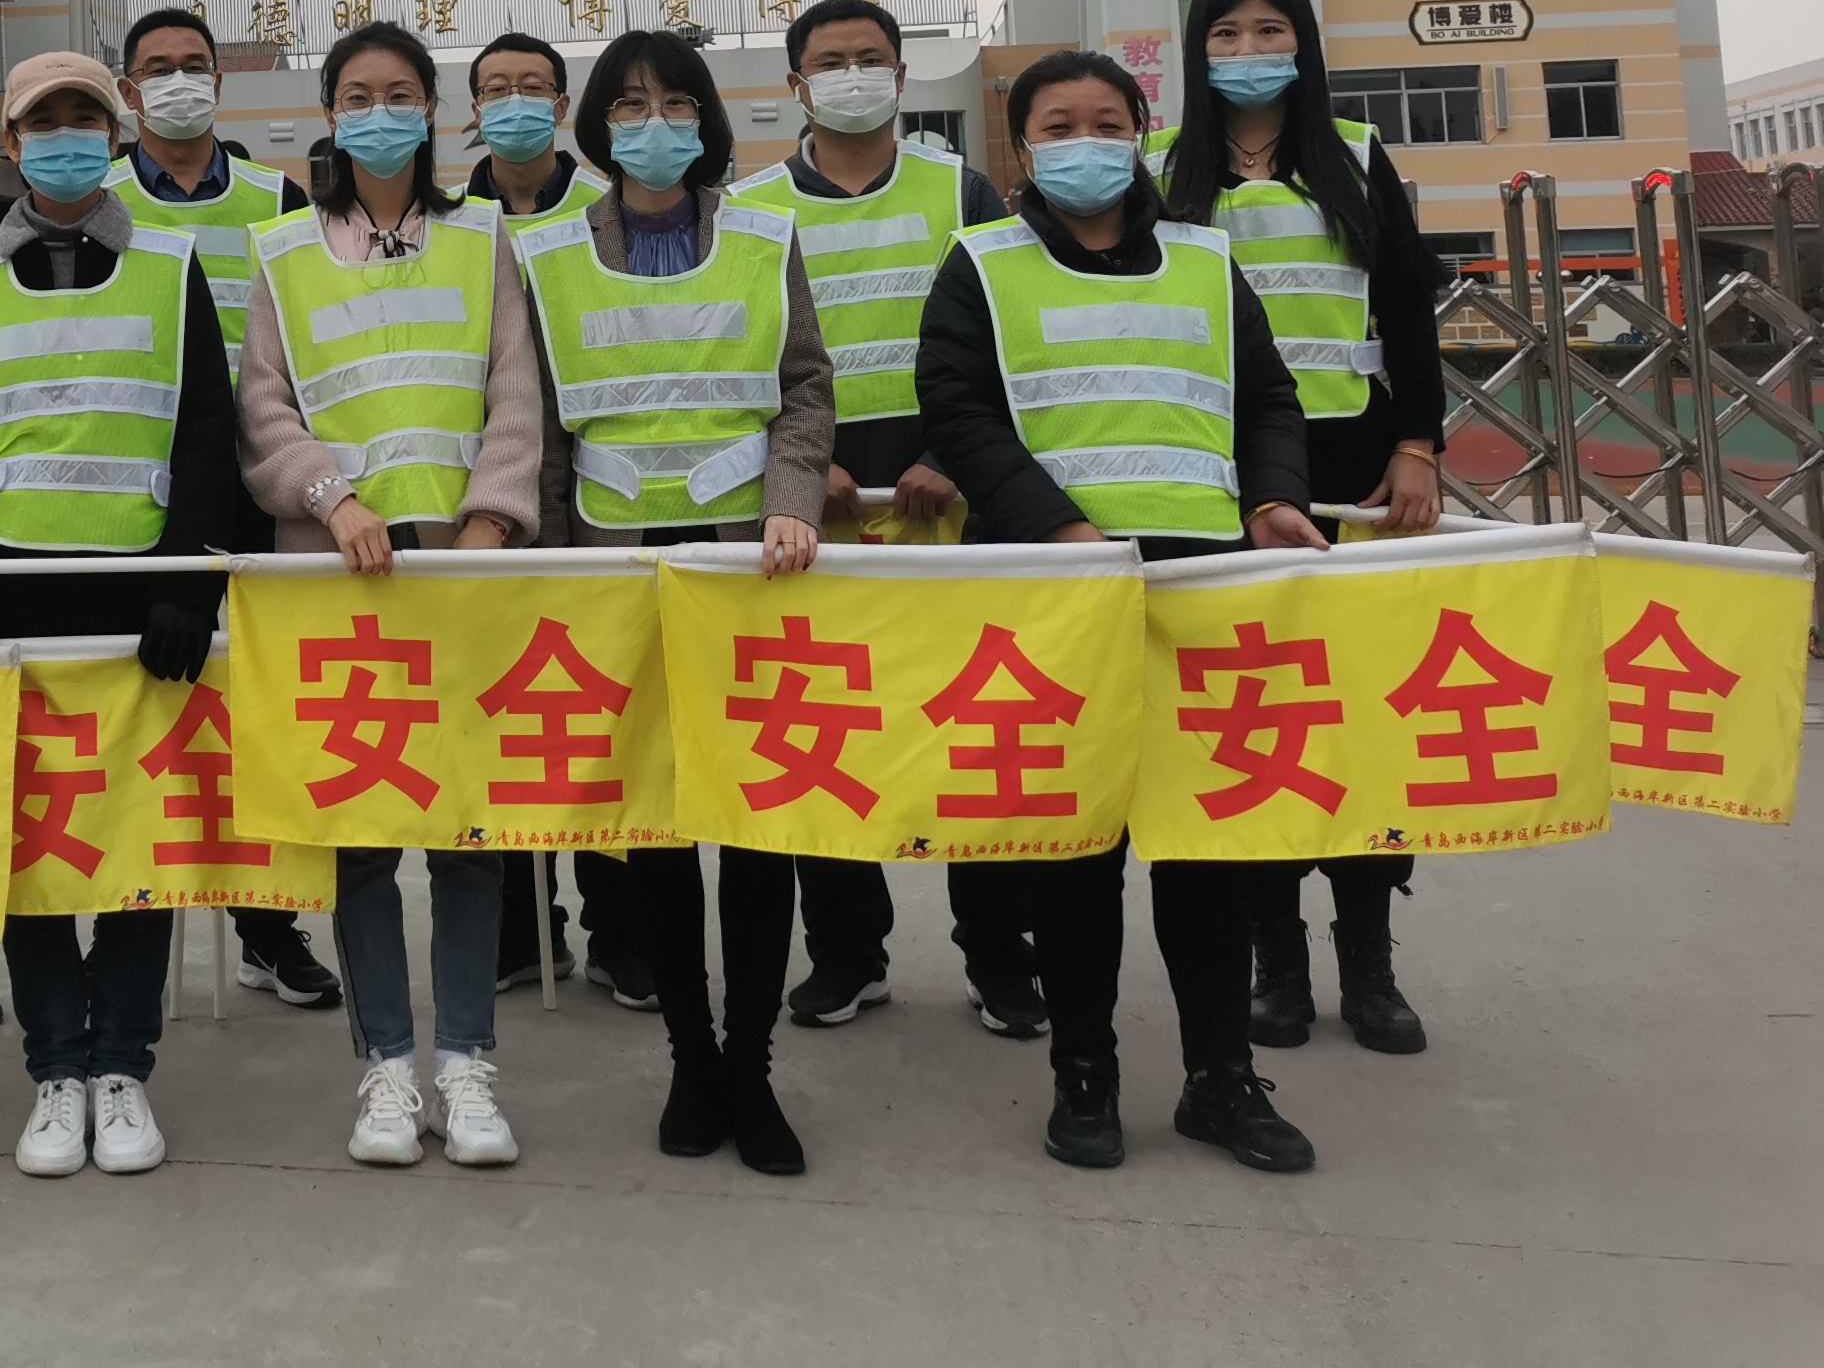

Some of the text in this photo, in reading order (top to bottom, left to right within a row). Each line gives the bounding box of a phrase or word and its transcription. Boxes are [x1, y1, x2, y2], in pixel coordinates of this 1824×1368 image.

[1122, 35, 1165, 130] 教育
[1428, 3, 1514, 27] 博爱楼
[1430, 31, 1445, 39] BO
[1466, 28, 1515, 37] BUILDING
[11, 682, 271, 880] 安全
[296, 614, 632, 812] 安全
[725, 615, 1086, 821] 安全
[1177, 607, 1558, 820] 安全
[1604, 599, 1741, 777] 全
